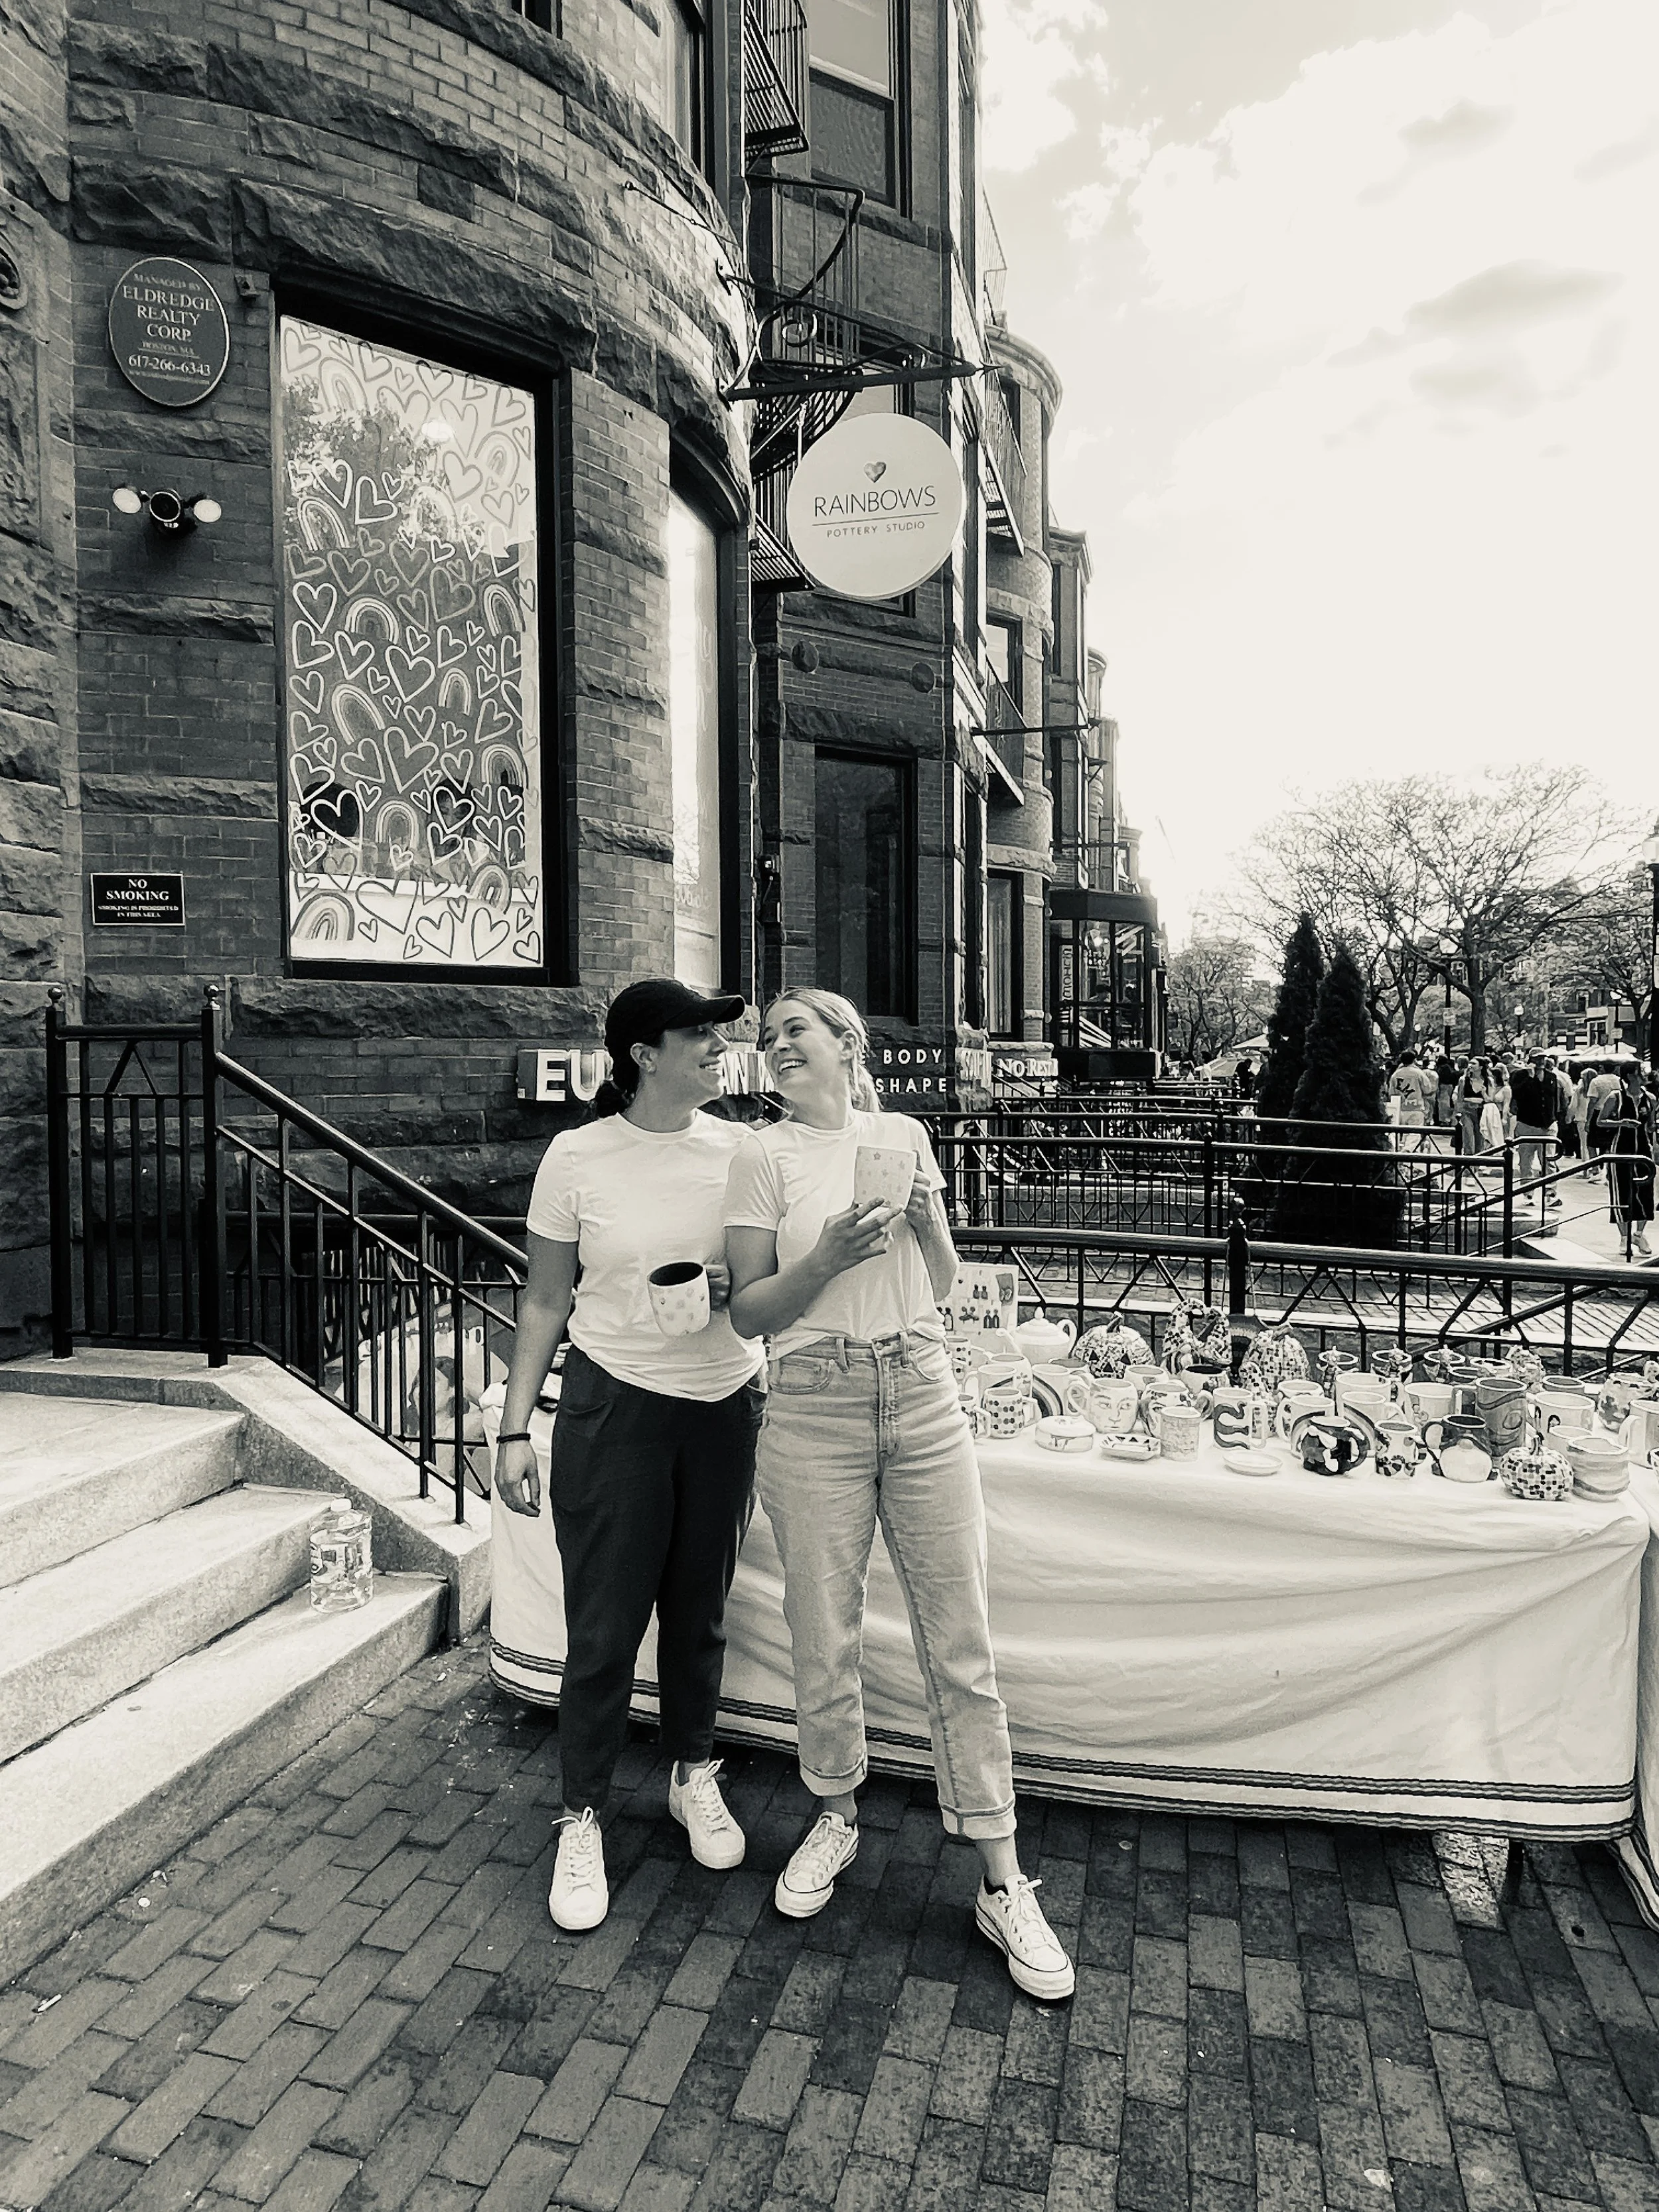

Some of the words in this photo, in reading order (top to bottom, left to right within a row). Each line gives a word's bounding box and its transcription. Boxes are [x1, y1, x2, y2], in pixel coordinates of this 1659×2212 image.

[123, 285, 215, 312] ELDREDGE
[137, 305, 200, 326] REALTY
[128, 354, 211, 376] 617-266-6343
[814, 485, 936, 517] RAINBOWS
[826, 525, 878, 538] POTTERY
[886, 520, 925, 532] STUDIO
[128, 879, 147, 889] NO
[106, 890, 169, 901] SMOKING
[883, 1049, 942, 1064] BODY
[875, 1077, 947, 1093] SHAPE
